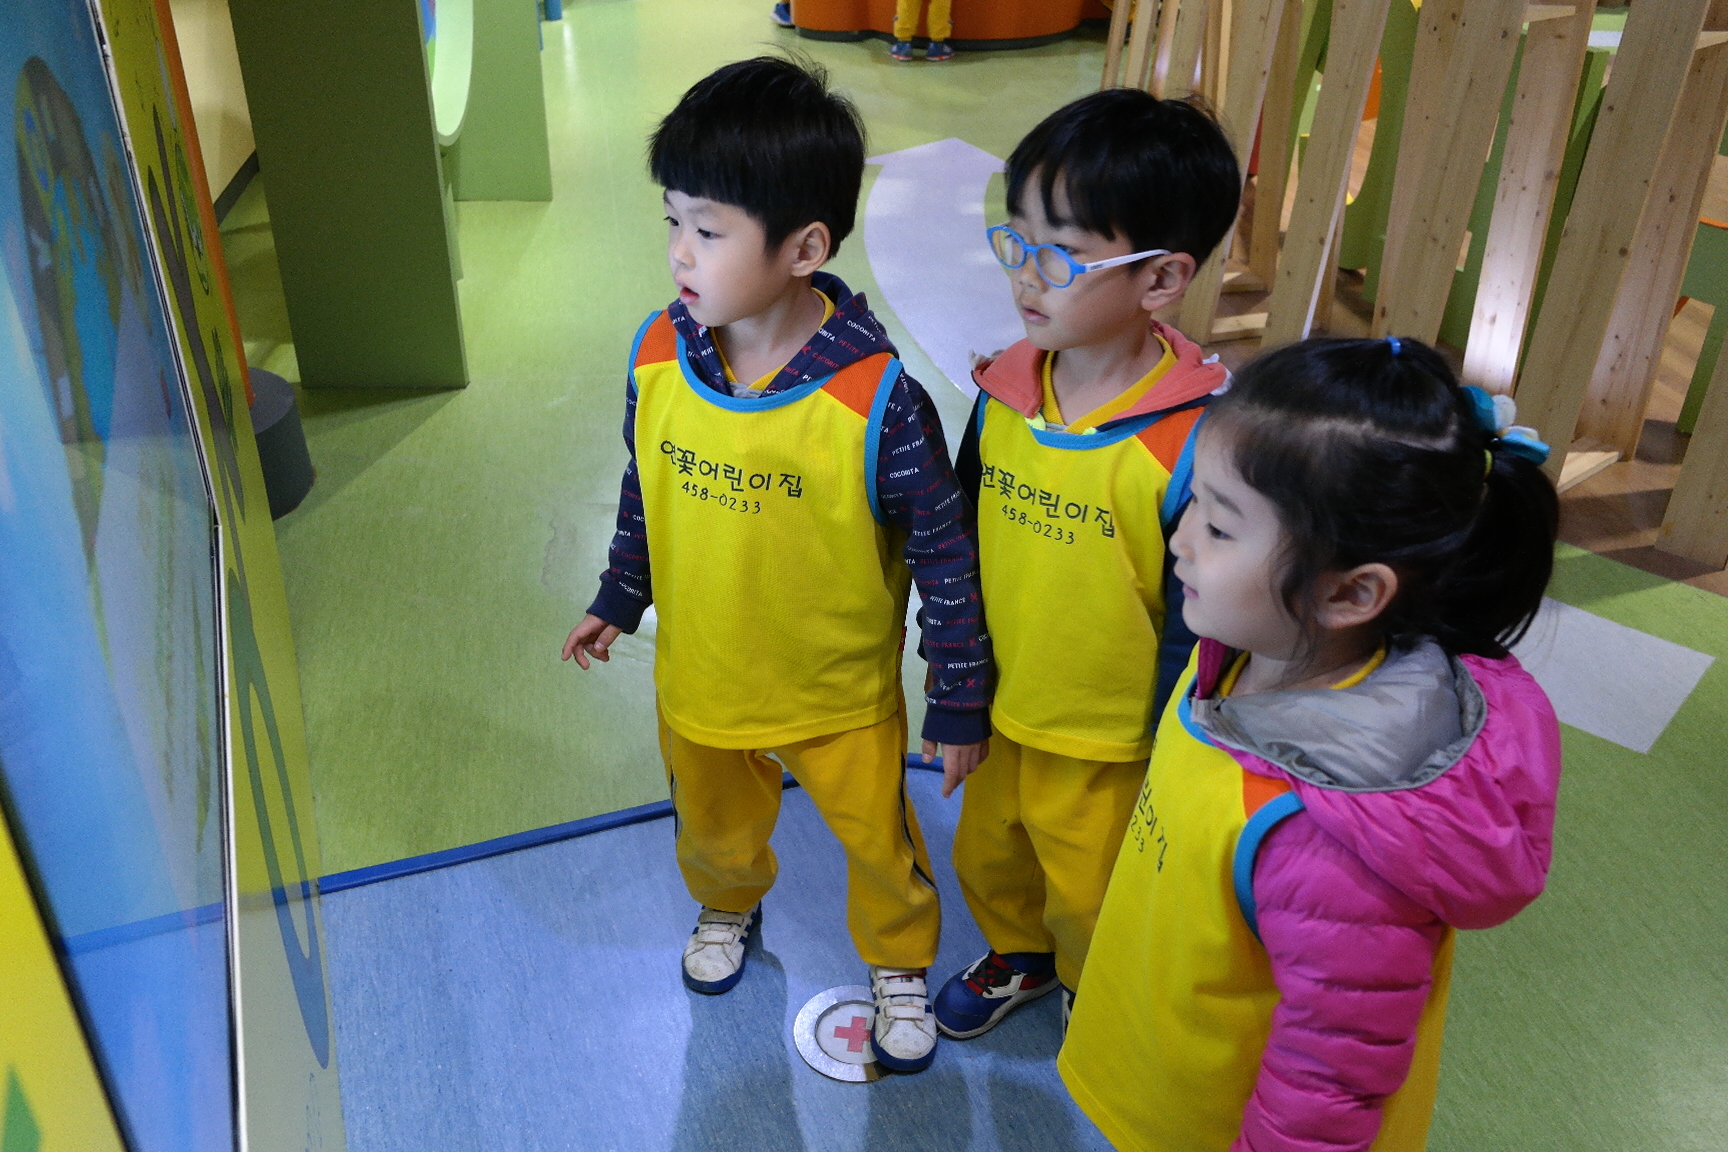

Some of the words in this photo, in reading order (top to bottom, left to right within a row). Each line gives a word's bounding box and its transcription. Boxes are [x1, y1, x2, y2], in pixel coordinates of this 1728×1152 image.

[846, 320, 876, 342] COCORITA
[812, 352, 840, 369] COCORIT
[660, 440, 803, 498] 연꽃어린이집
[889, 467, 920, 479] COCORITA
[681, 481, 761, 514] 458-0233
[982, 463, 1115, 538] 연꽃어린이집
[1001, 504, 1075, 545] 458-0233
[943, 596, 966, 606] FRANCE
